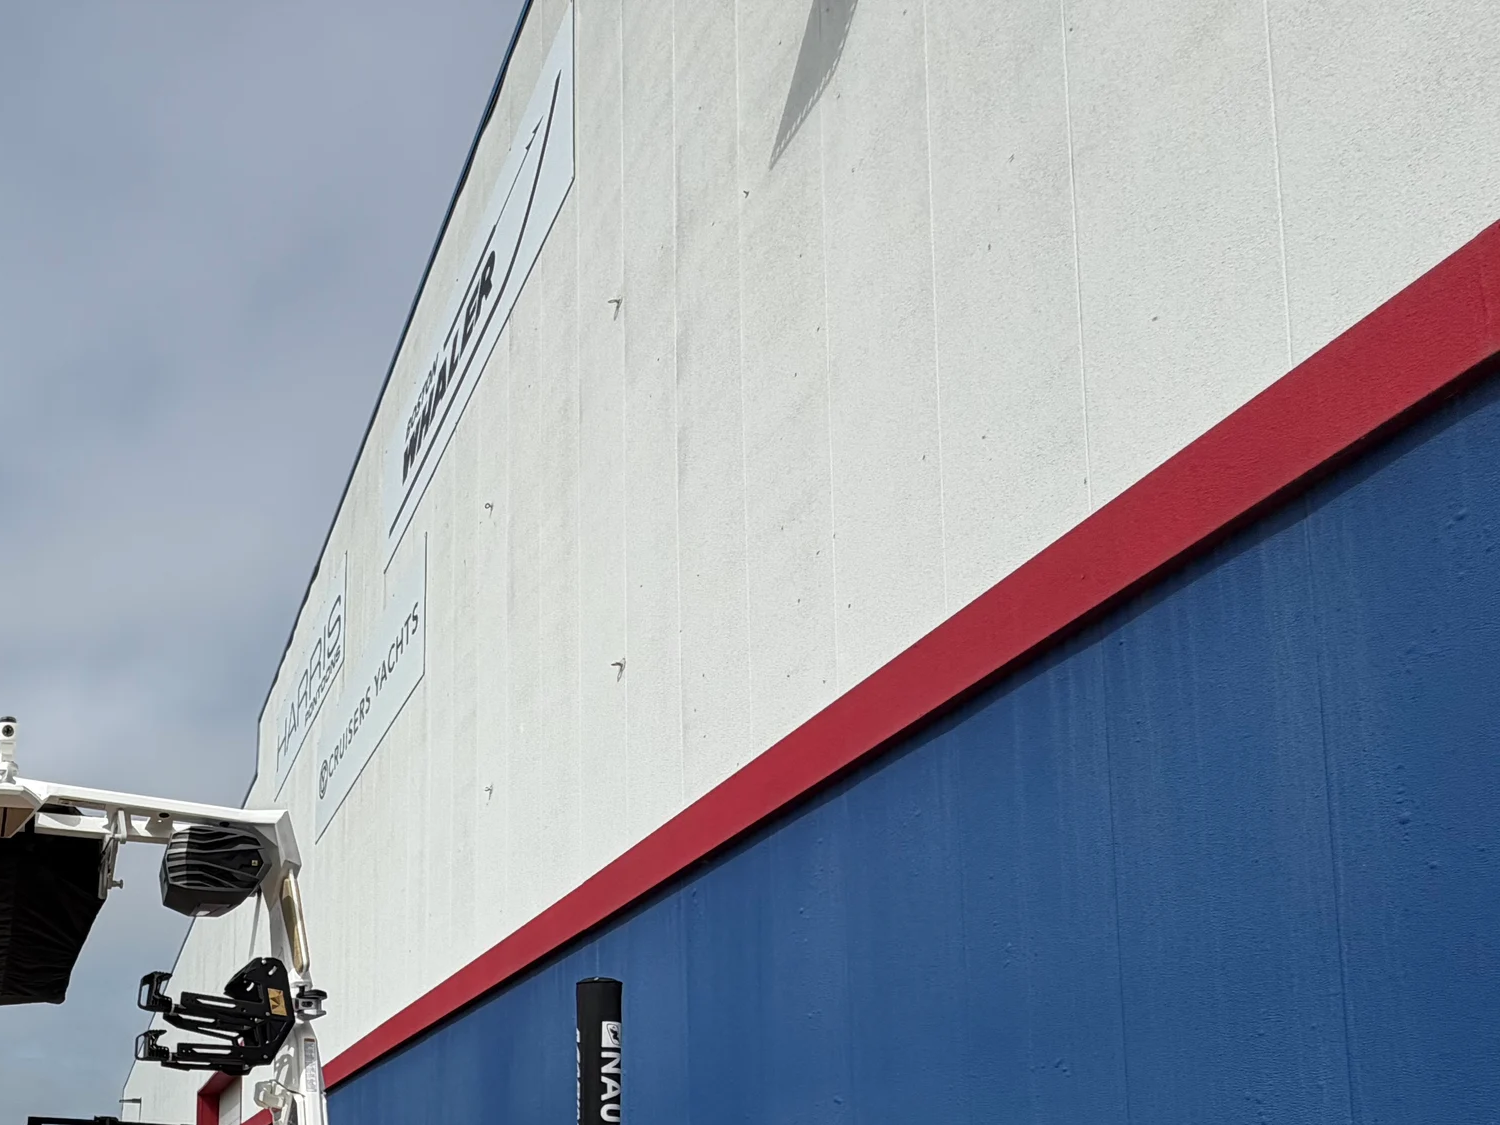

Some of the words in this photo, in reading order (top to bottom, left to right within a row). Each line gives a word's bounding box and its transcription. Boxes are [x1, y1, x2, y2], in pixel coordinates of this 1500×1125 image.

[402, 250, 496, 487] WHALER
[405, 351, 440, 444] BOSTON
[276, 594, 342, 773] HARRIS
[304, 644, 341, 727] PONTOONS
[328, 686, 371, 778] CRUISERS
[373, 601, 419, 697] YACHTS
